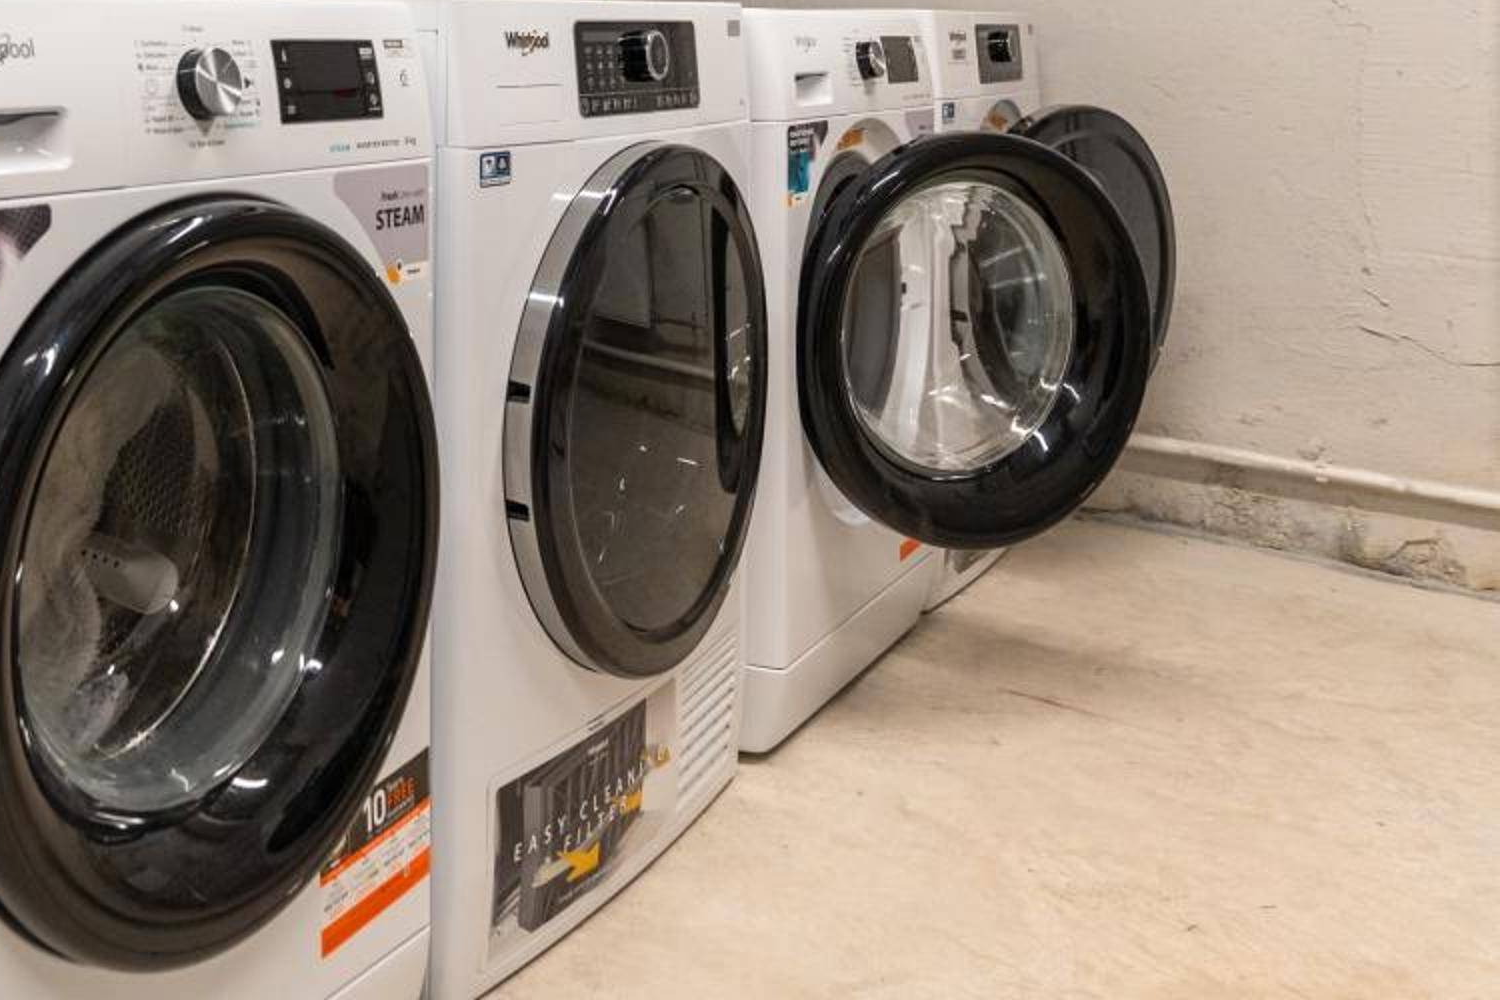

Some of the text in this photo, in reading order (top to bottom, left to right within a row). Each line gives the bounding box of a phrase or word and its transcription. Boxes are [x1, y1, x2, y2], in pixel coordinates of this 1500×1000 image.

[375, 203, 425, 231] STEAM
[363, 788, 387, 833] 10
[513, 816, 566, 863] EASY
